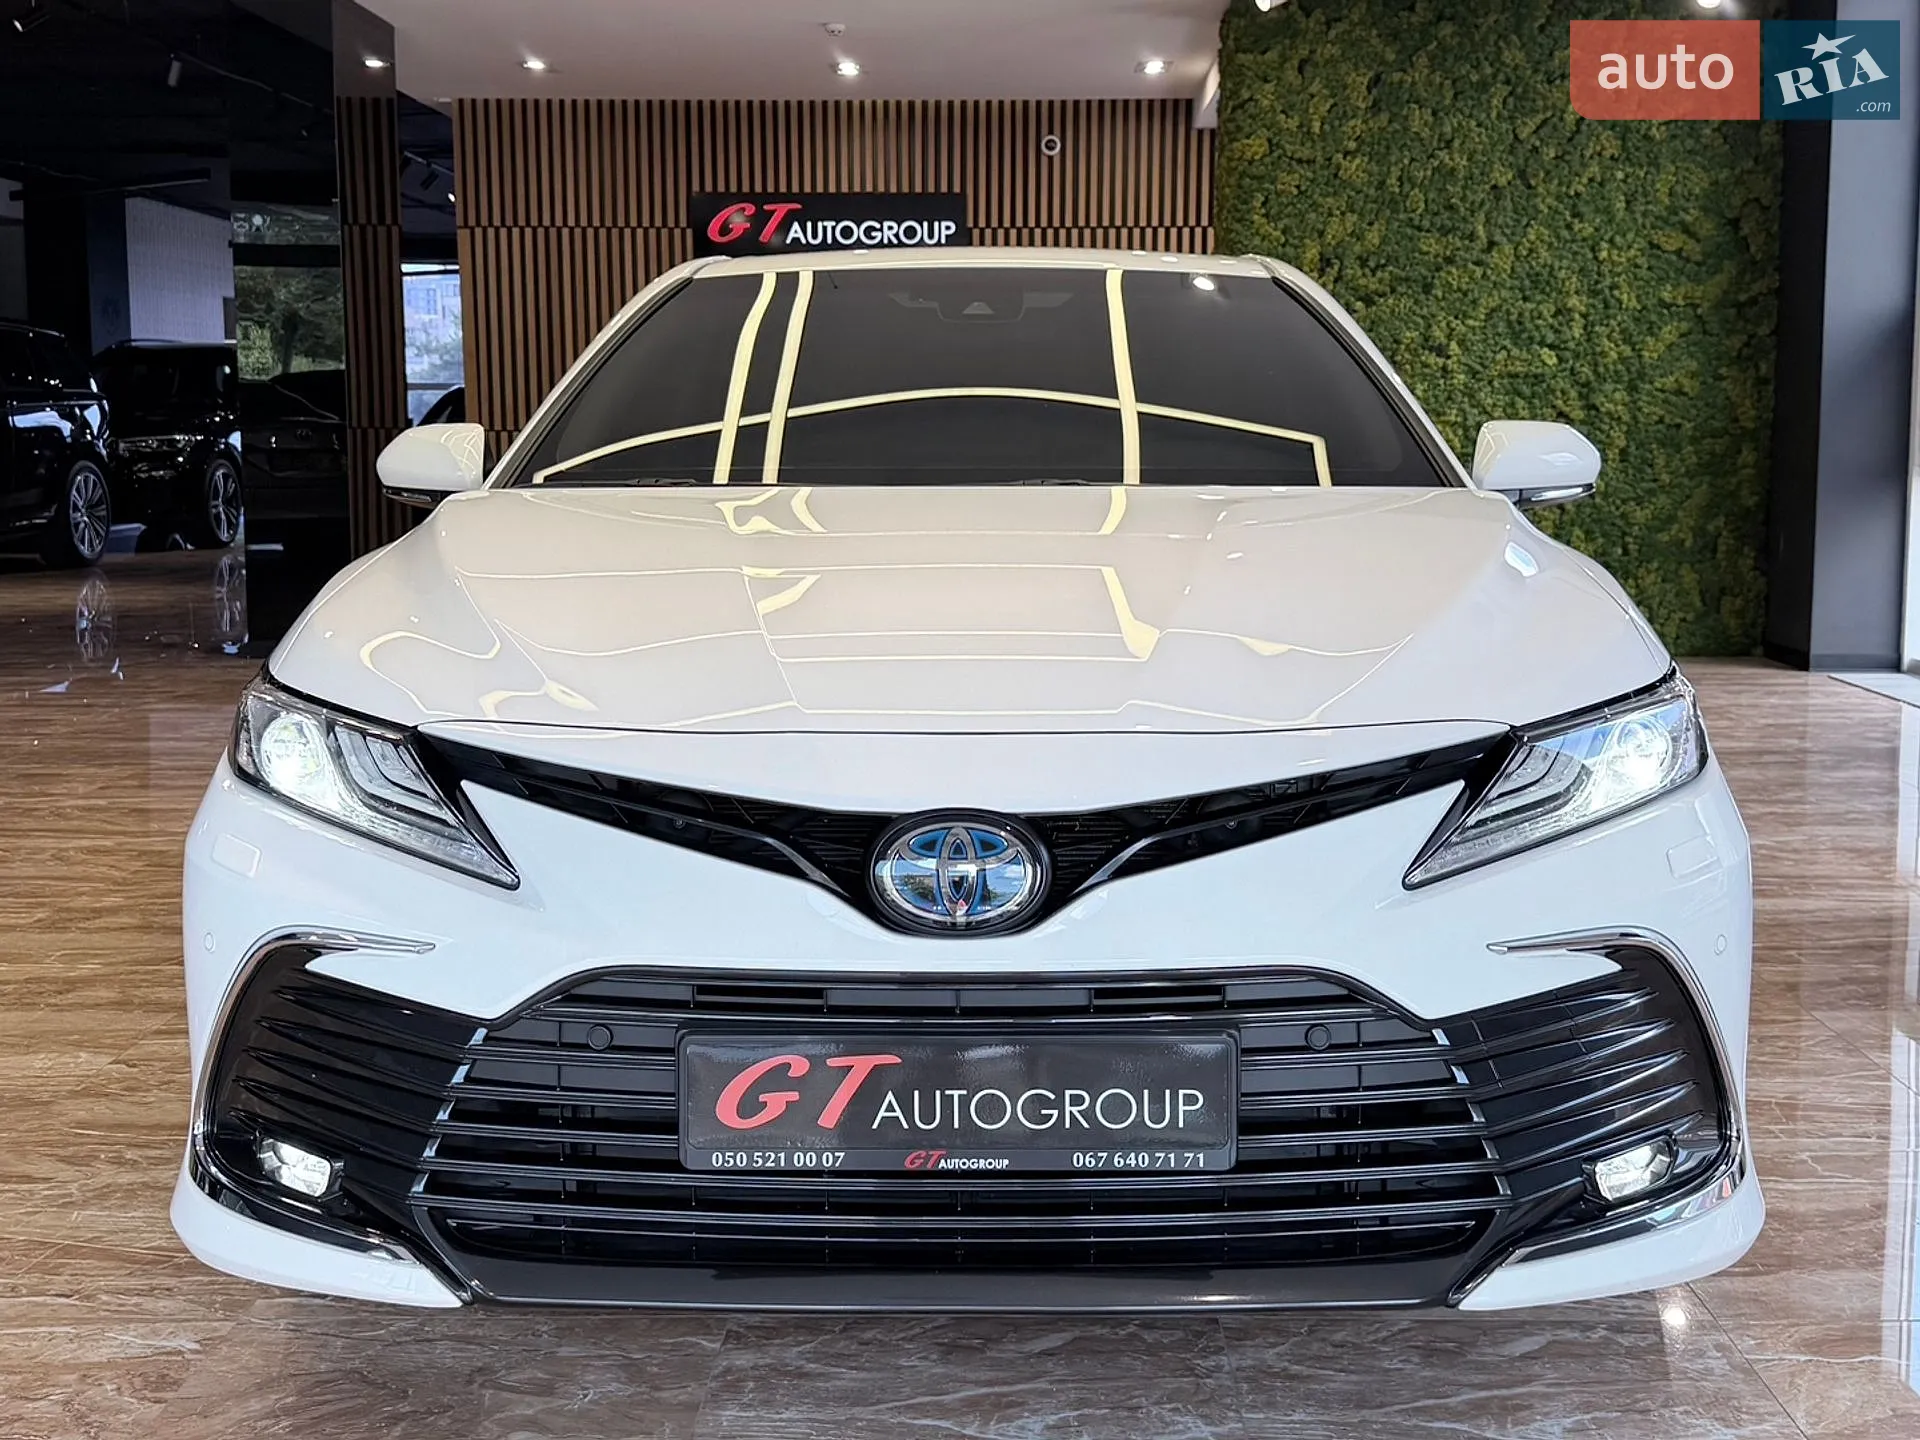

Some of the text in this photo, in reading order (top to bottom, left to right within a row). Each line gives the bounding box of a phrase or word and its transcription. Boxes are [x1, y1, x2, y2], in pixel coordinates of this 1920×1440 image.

[706, 202, 957, 245] GT AUTOGROUP
[714, 1054, 1205, 1131] GT AUTOGROUP
[711, 1151, 846, 1168] 050 521 00 07
[904, 1150, 1009, 1169] GT AUTOGROUP
[1072, 1151, 1204, 1168] 067 640 71 71
